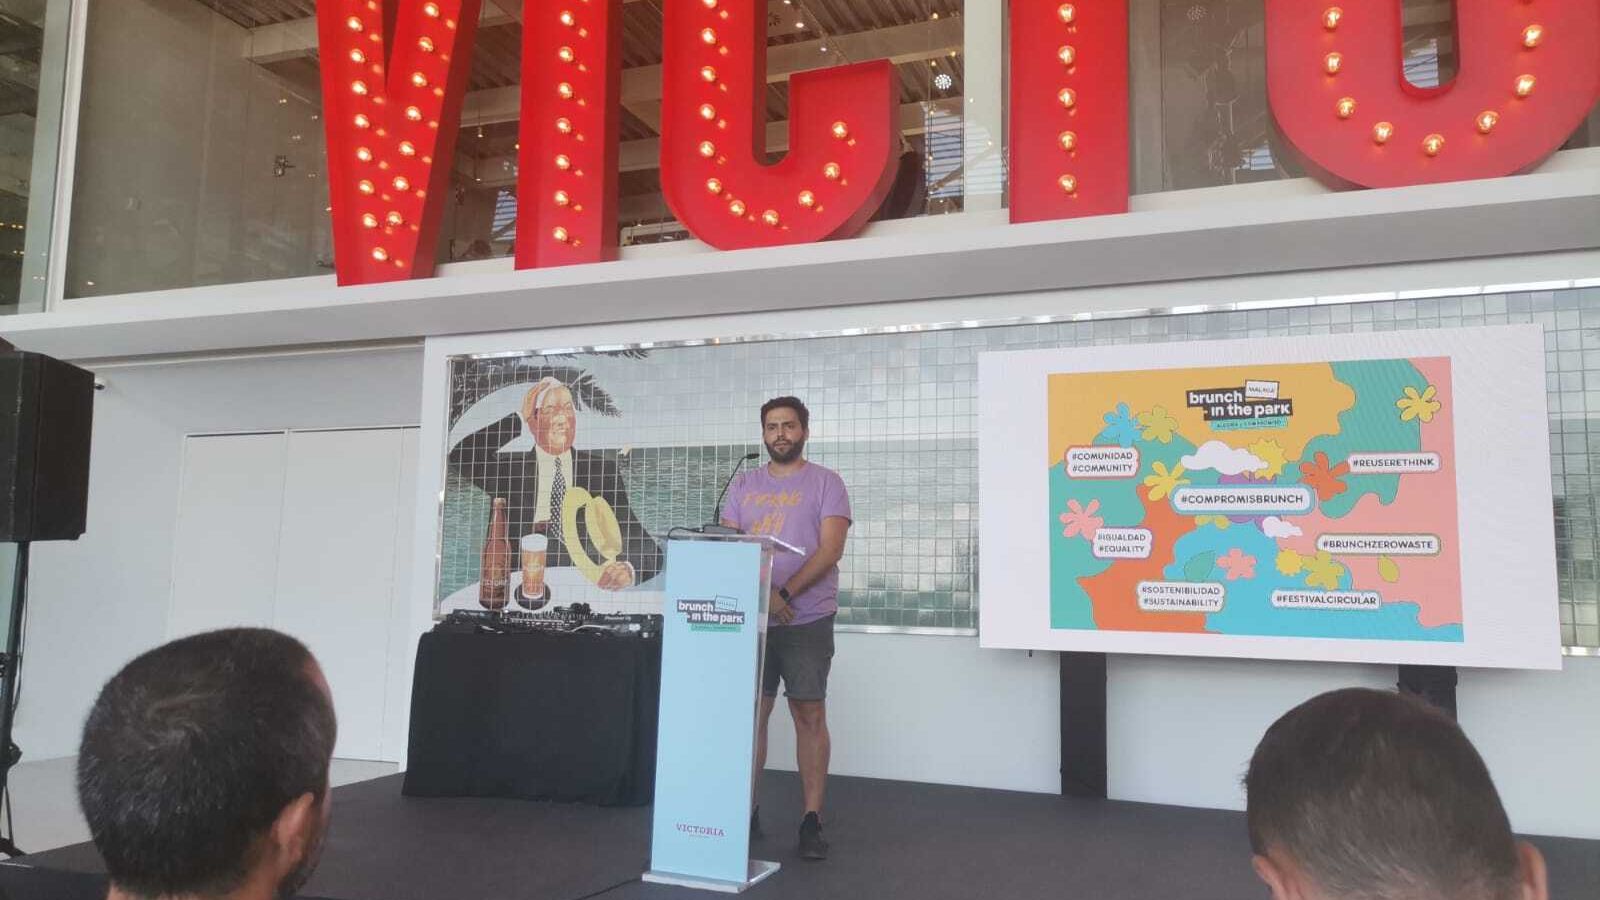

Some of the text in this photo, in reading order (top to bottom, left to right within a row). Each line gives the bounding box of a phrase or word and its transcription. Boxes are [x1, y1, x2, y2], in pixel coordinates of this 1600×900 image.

[1189, 390, 1243, 404] brunch
[1227, 403, 1252, 416] the
[1254, 403, 1291, 418] park
[1072, 451, 1133, 461] #COMUNIDAD
[1353, 458, 1434, 467] #REUSERETHINK
[1072, 464, 1133, 473] #COMMUNITY
[1181, 494, 1304, 504] #COMPROMISBRUNCH
[1098, 533, 1146, 541] #IGUALDAD
[1099, 545, 1145, 553] #EQUALITY
[1323, 540, 1433, 549] #BRUNCHZEROWASTE
[1142, 586, 1220, 595] #SOSTENIBILIDAD
[1144, 598, 1219, 607] #SUSTAINABILITY
[1276, 594, 1376, 605] #FESTIVALCIRCULAR
[678, 601, 714, 612] brunch
[703, 611, 719, 622] the
[720, 614, 744, 624] park
[676, 822, 725, 837] VICTORIA
